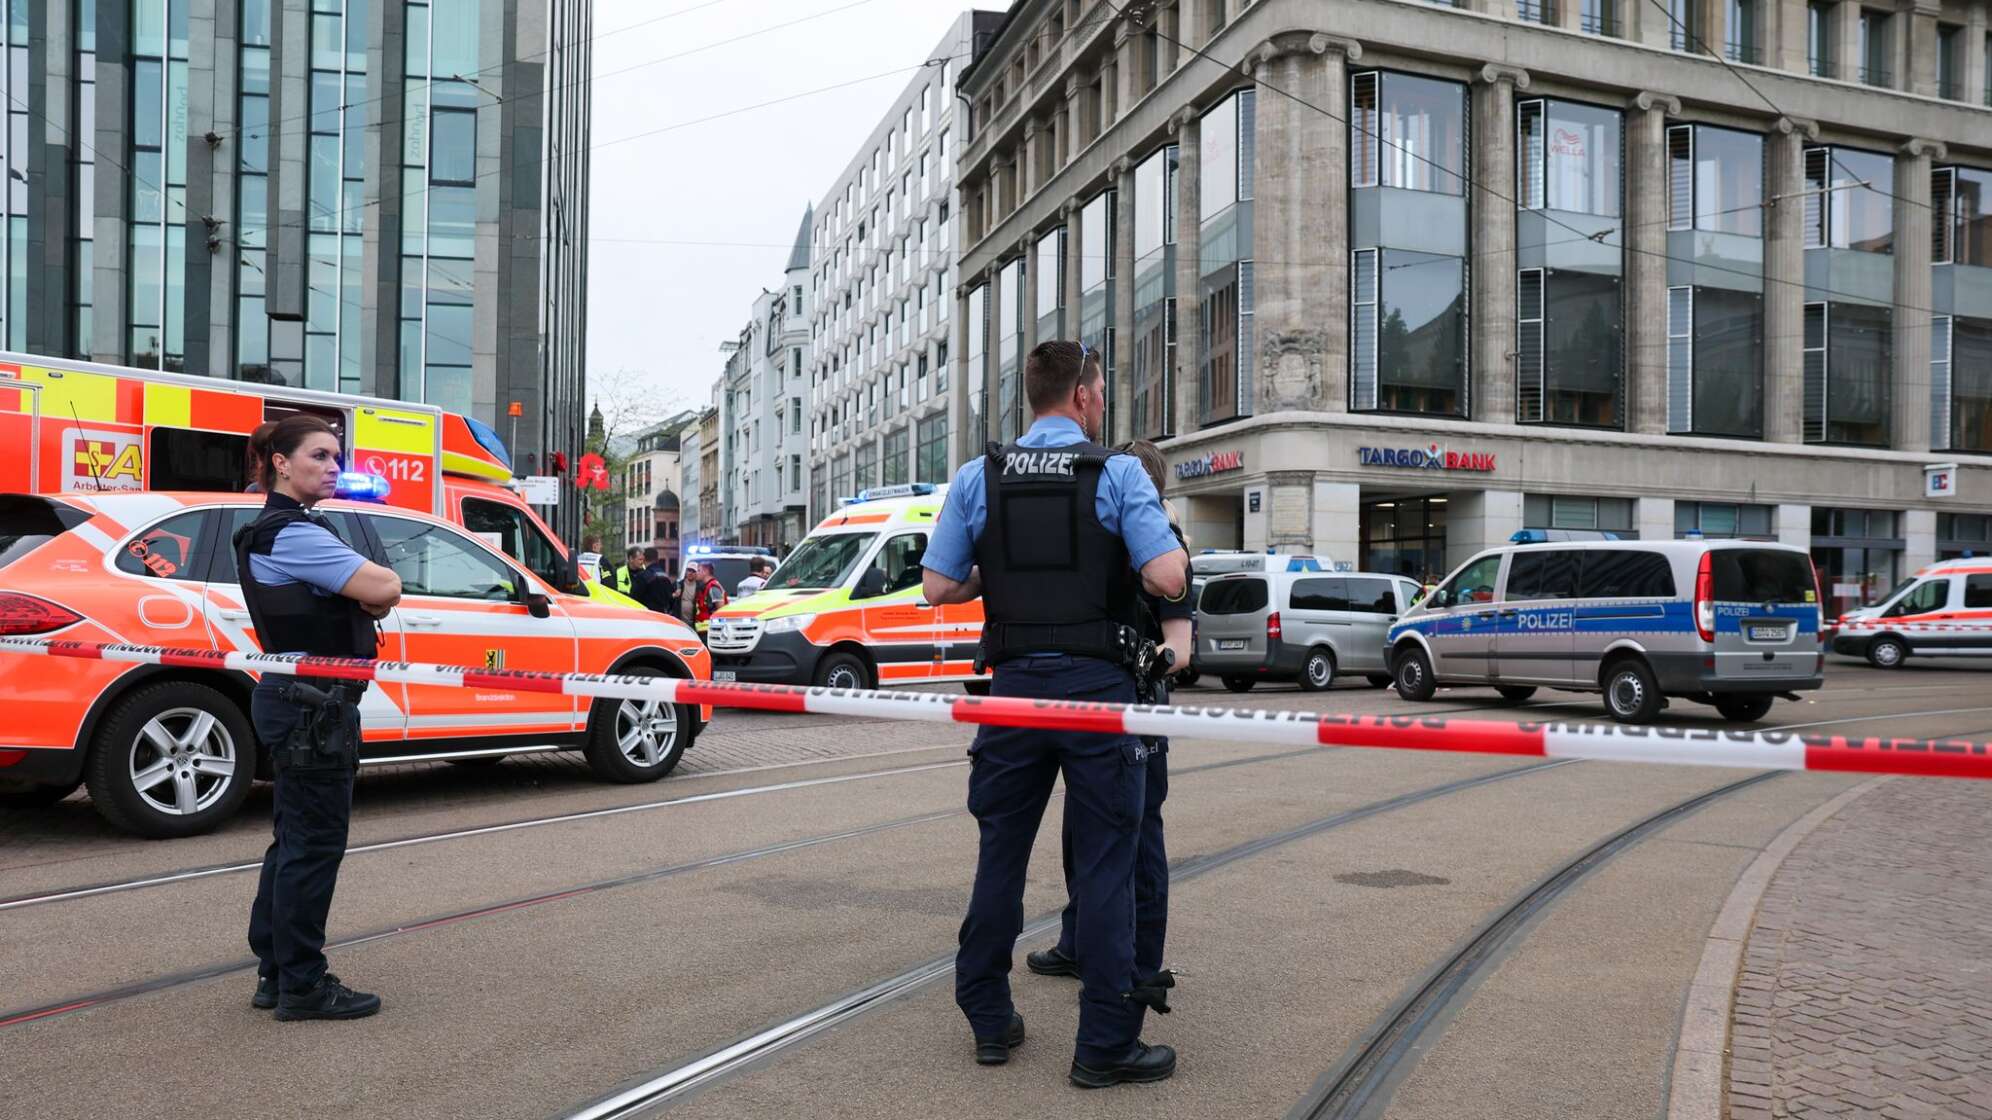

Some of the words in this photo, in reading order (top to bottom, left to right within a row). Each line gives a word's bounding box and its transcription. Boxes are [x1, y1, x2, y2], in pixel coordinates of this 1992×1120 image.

[388, 458, 424, 482] 112
[144, 553, 176, 577] 112
[1518, 612, 1573, 629] POLIZEI
[1718, 607, 1750, 616] POLIZEI
